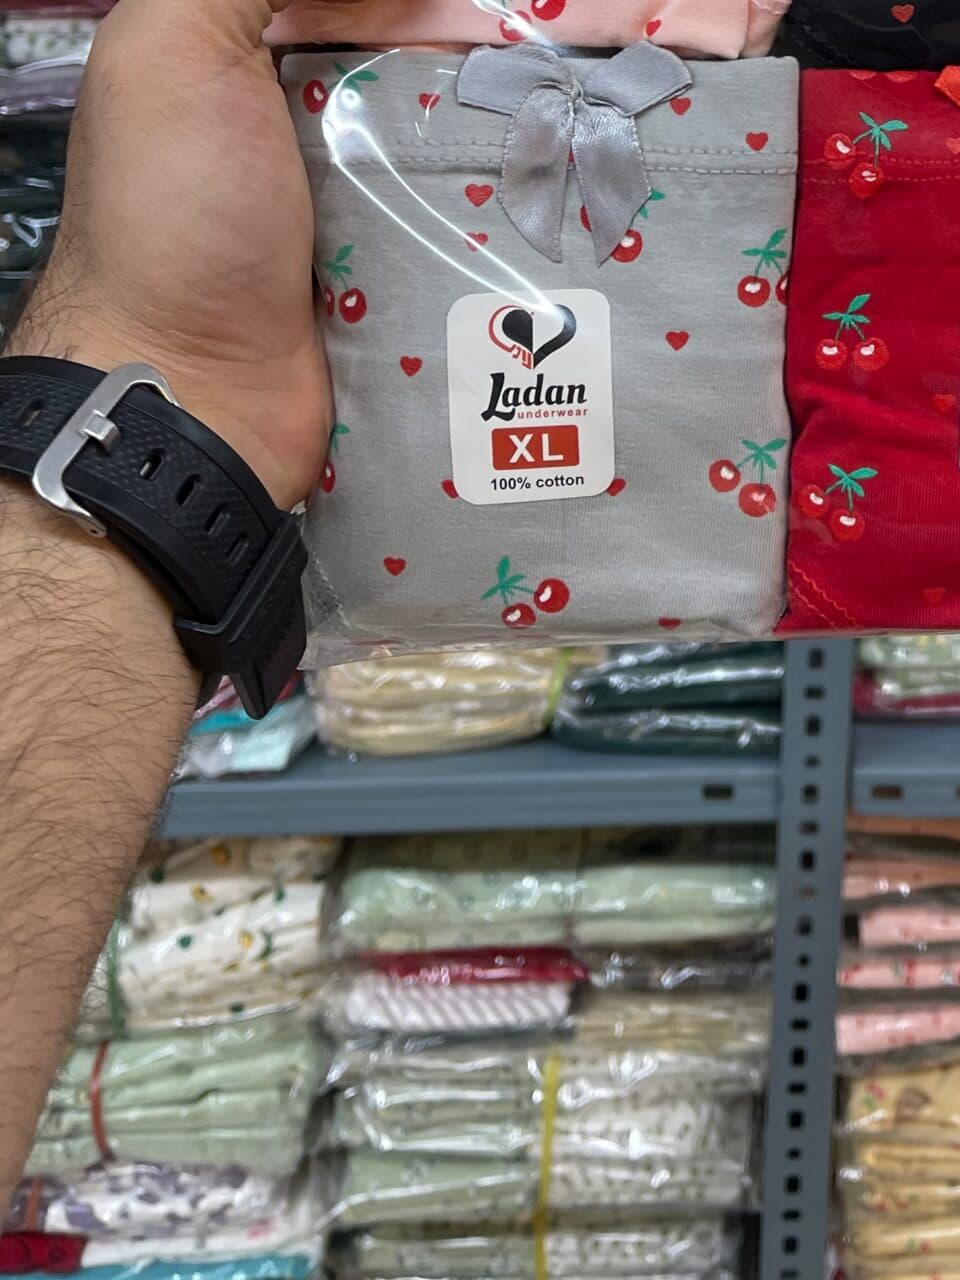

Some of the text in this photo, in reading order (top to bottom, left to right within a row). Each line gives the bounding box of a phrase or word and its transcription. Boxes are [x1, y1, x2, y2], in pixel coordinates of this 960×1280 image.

[481, 372, 587, 422] Ladan
[517, 407, 588, 419] underwear
[508, 433, 564, 464] XL
[490, 475, 585, 491] 100% cotton
